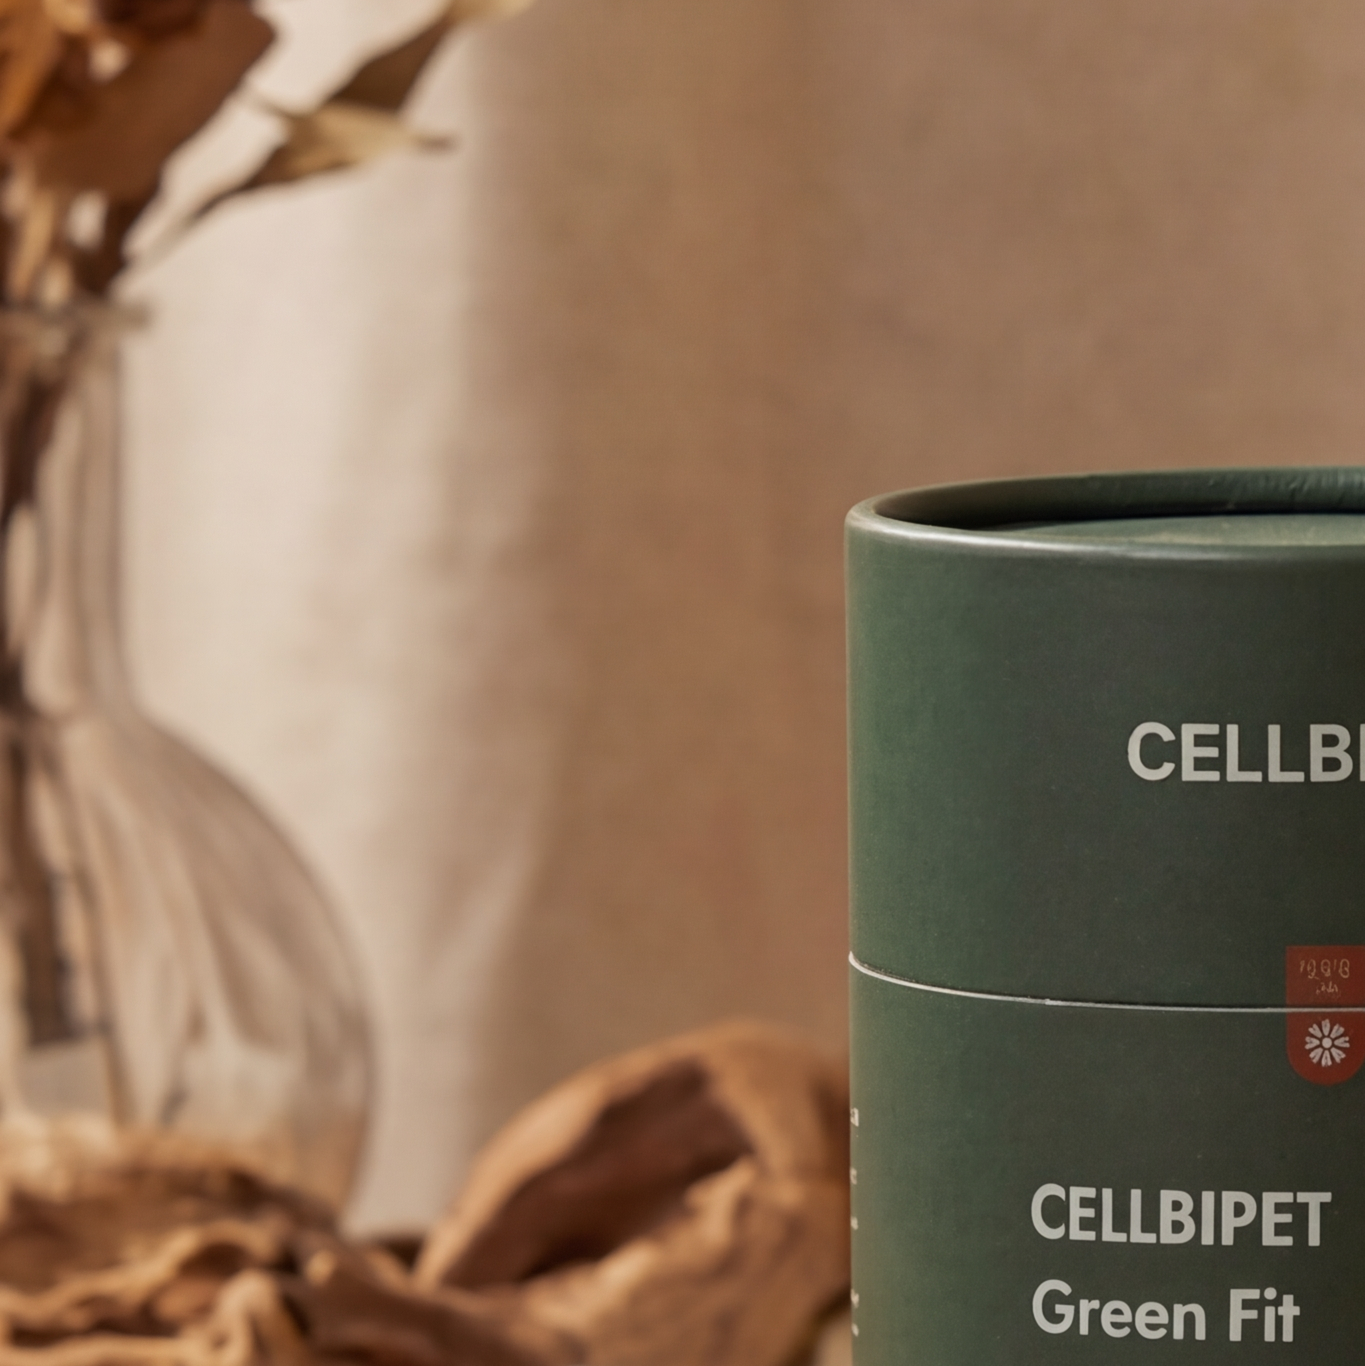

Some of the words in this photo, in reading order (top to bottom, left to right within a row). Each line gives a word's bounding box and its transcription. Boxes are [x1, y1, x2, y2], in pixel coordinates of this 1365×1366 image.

[1031, 1182, 1332, 1247] CELLBIPET
[1031, 1279, 1207, 1341] Green
[1228, 1286, 1301, 1343] Fit
